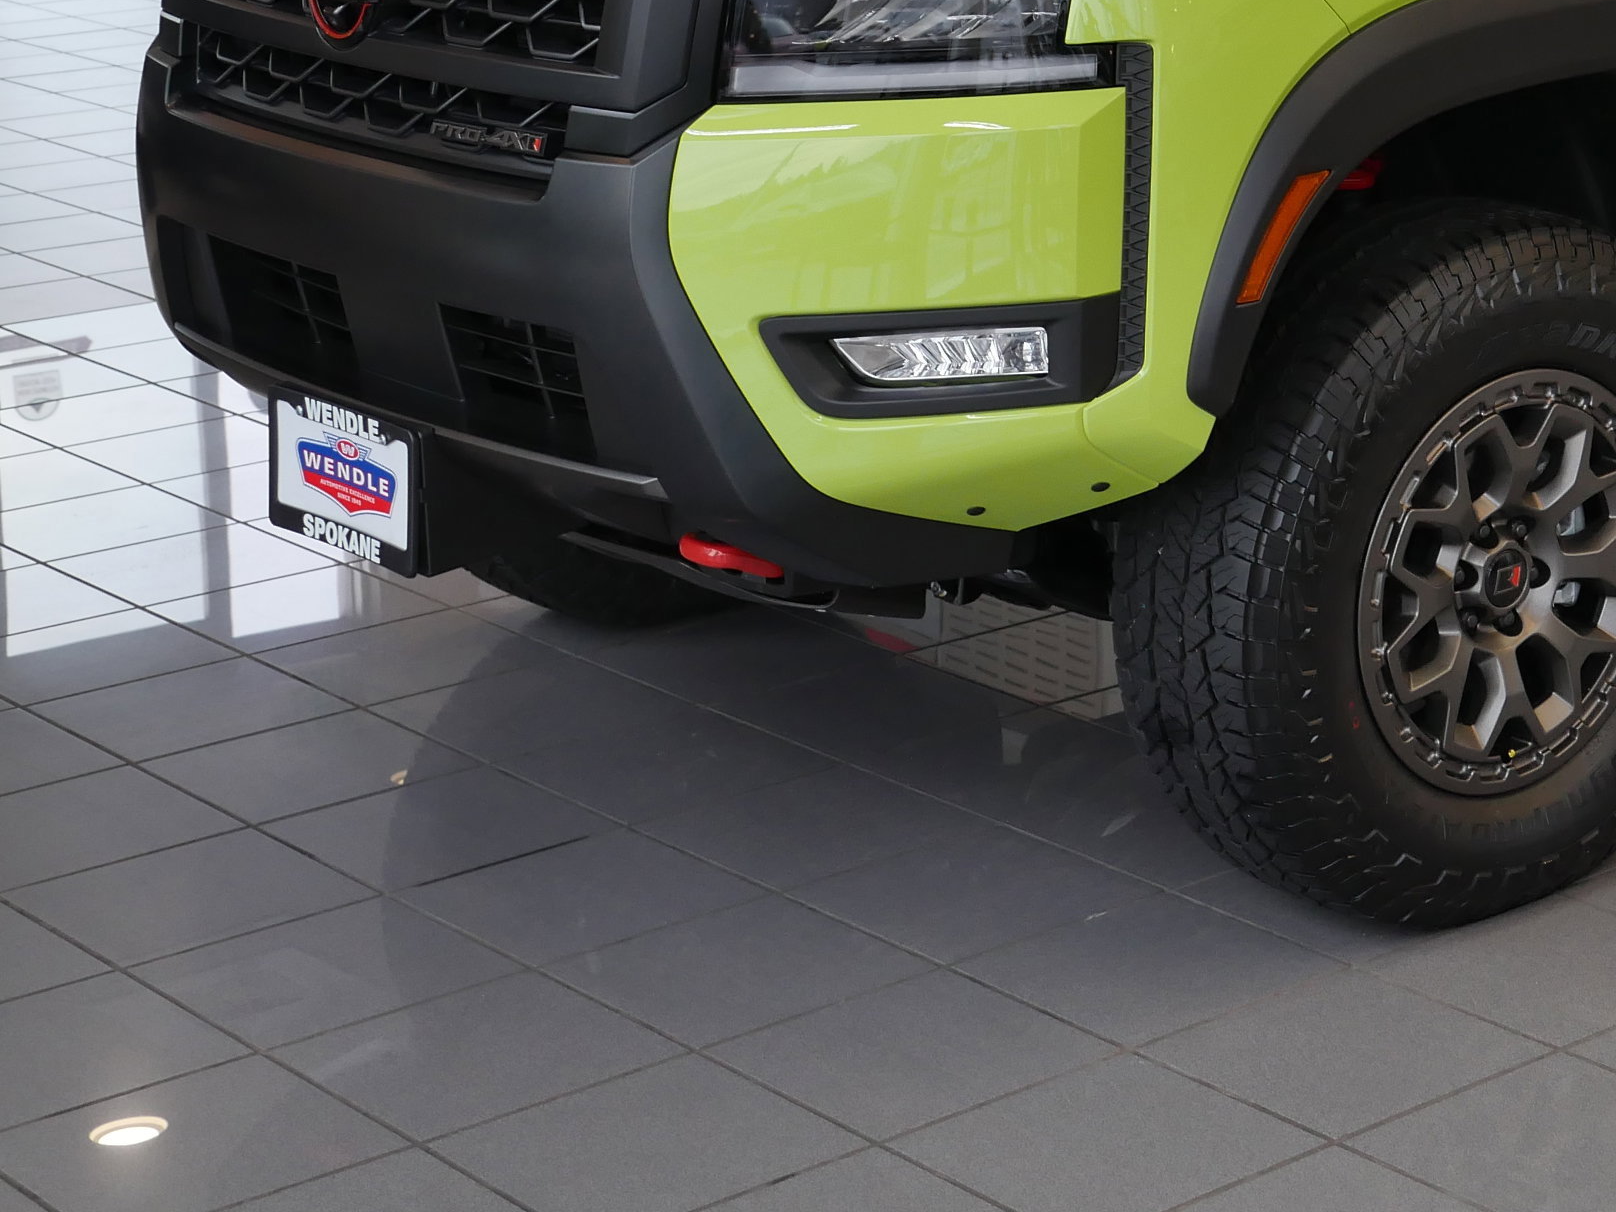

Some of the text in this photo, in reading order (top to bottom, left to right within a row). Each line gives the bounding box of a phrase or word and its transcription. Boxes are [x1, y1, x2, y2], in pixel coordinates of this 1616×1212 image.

[304, 396, 380, 444] WENDLE
[303, 449, 389, 497] WENDLE
[303, 513, 381, 564] SPOKANE
